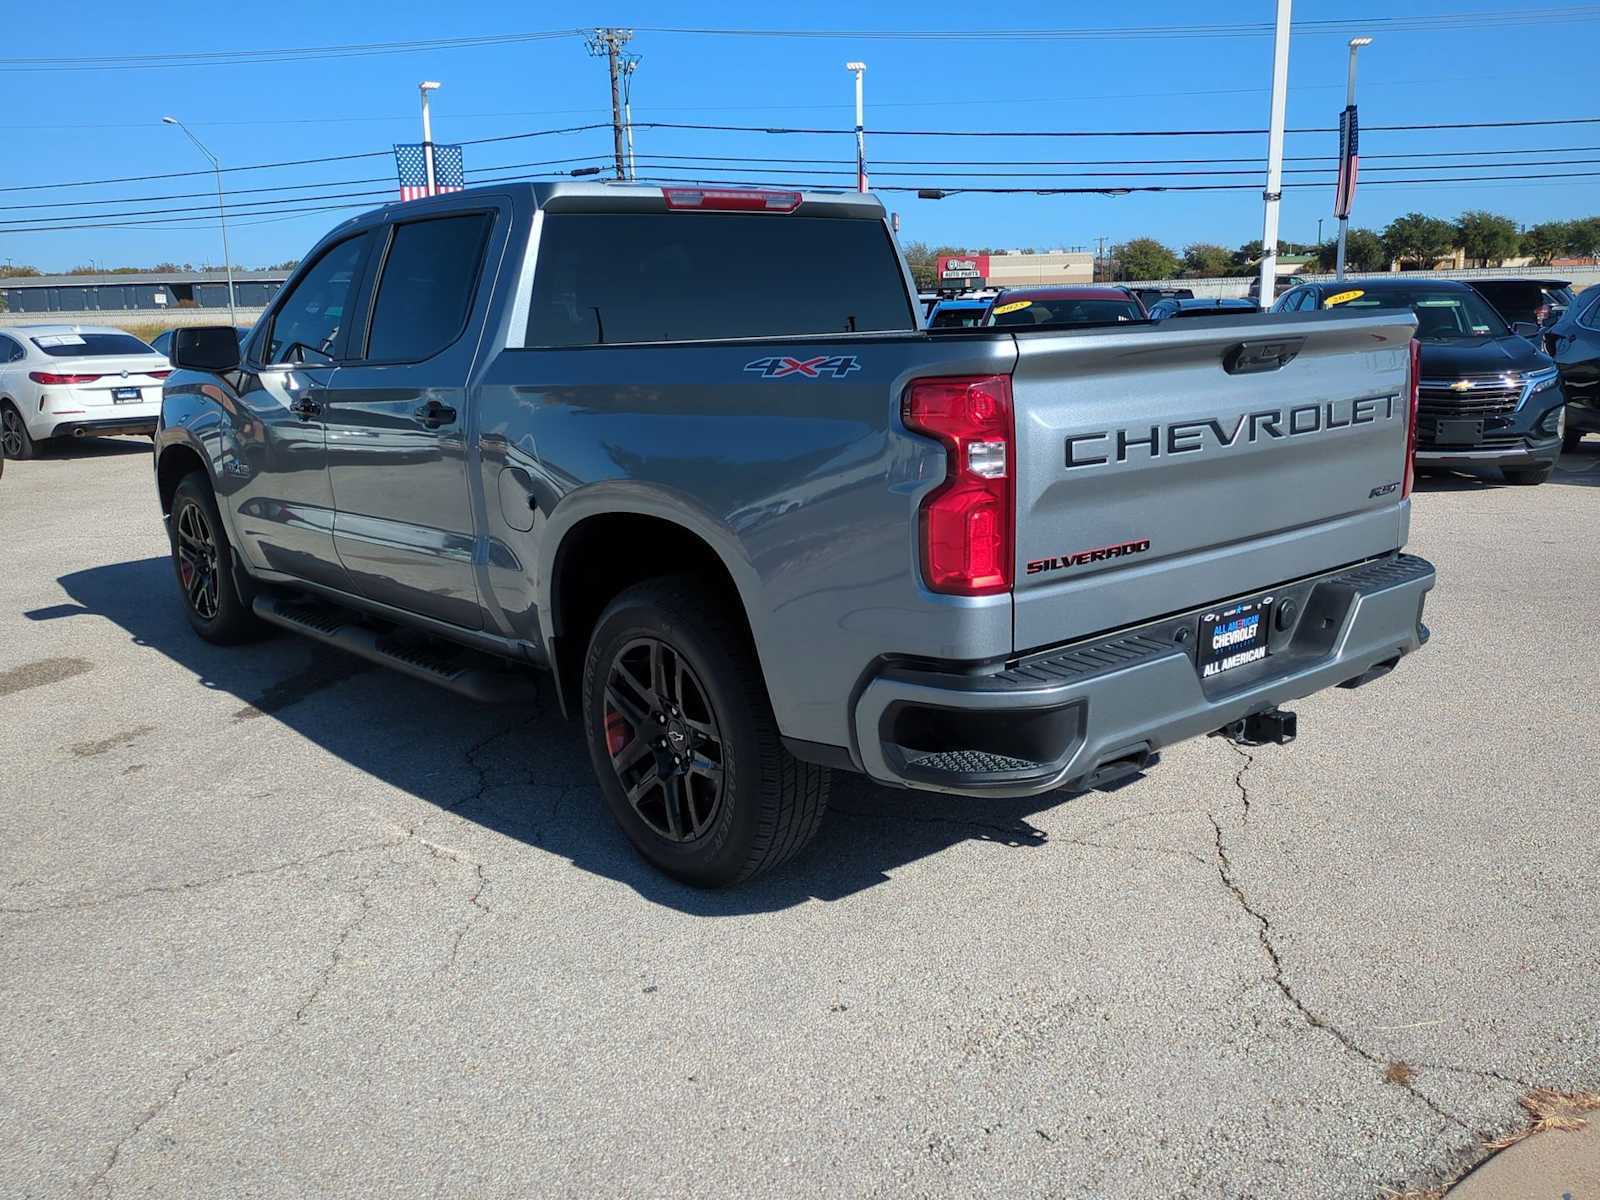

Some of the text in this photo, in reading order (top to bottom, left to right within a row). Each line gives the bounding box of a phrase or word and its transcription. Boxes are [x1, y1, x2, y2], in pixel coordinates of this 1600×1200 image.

[1065, 391, 1401, 470] CHEVROLET
[1368, 481, 1401, 499] RST
[1026, 538, 1150, 574] SILVERADO
[1212, 623, 1259, 650] CHEVROLET
[1228, 614, 1260, 632] AMERICAN
[1204, 660, 1221, 677] ALL
[1220, 646, 1266, 671] AMERICAN
